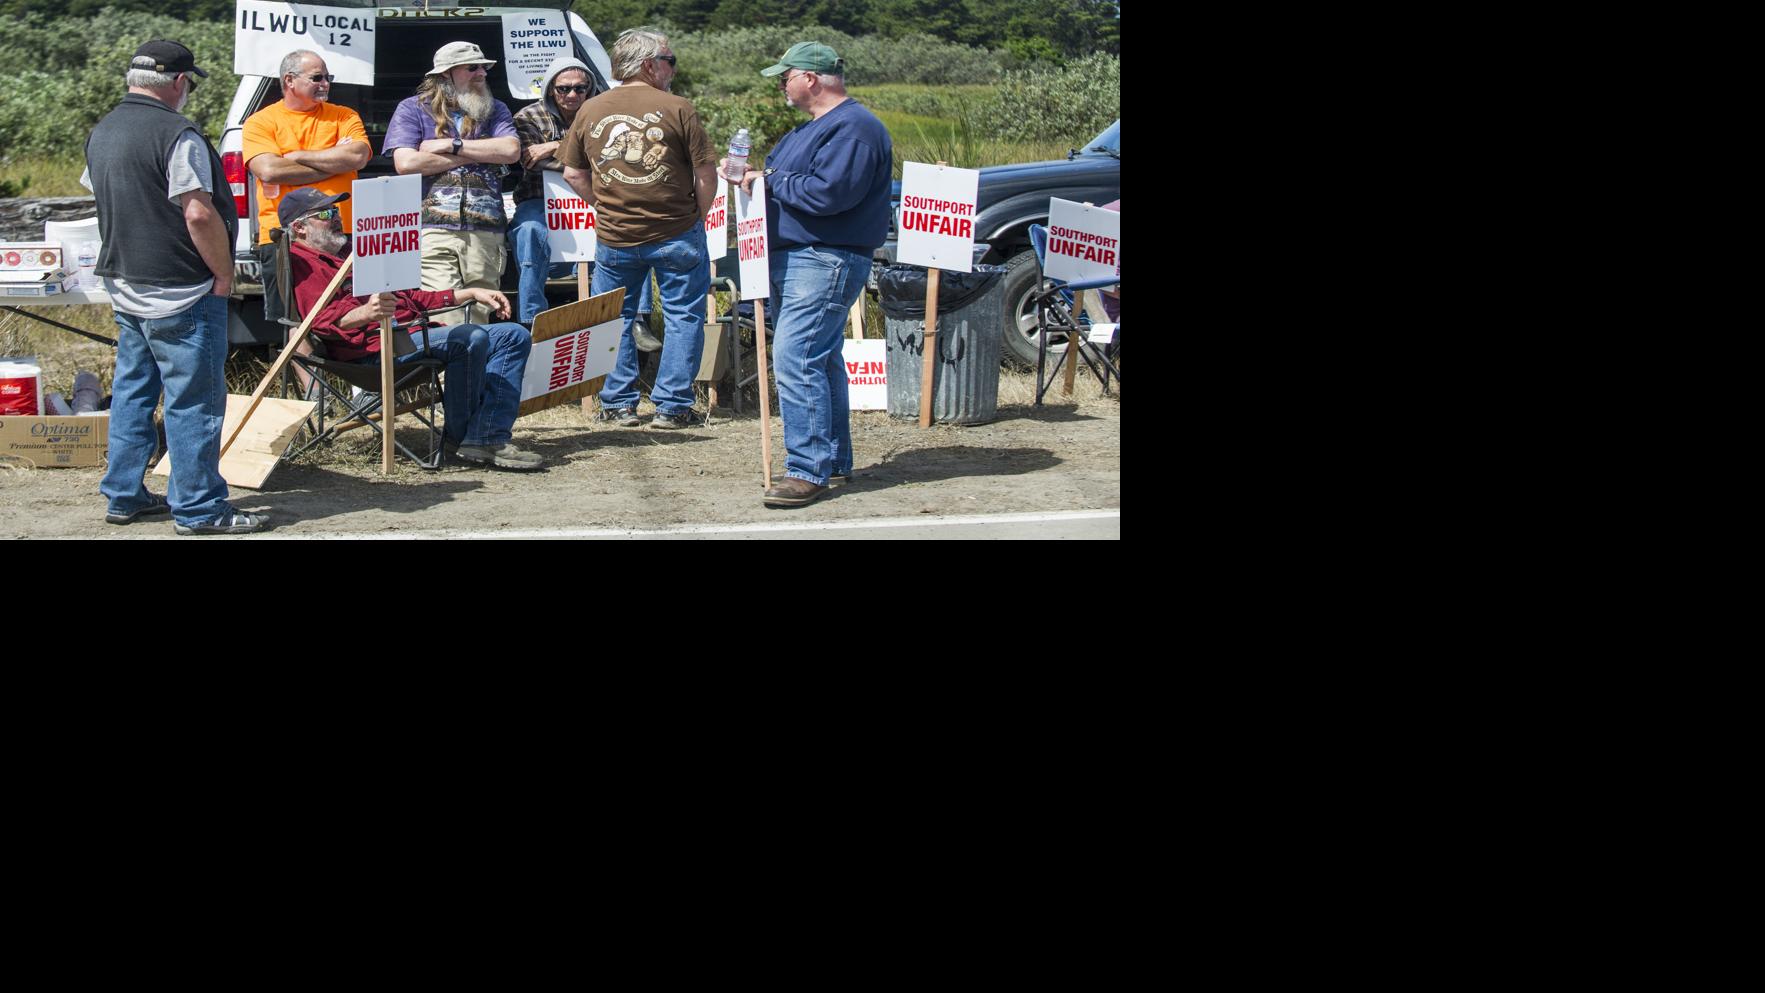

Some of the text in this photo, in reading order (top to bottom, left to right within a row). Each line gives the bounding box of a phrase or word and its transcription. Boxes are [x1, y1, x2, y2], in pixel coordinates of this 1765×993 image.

[241, 10, 373, 35] ILWU LOCAL
[528, 18, 546, 26] WE
[329, 32, 352, 47] 12
[510, 29, 565, 38] SUPPORT
[510, 40, 567, 49] THE ILWU
[904, 195, 974, 216] SOUTHPORT
[356, 212, 420, 232] SOUTHPORT
[737, 217, 764, 237] SOUTHPORT
[902, 210, 972, 239] UNFAIR
[356, 229, 420, 258] UNFAIR
[1050, 225, 1118, 249] SOUTHPORT
[739, 235, 766, 262] UNFAIR
[1049, 237, 1117, 266] UNFAIR
[548, 335, 576, 391] UNFAIR
[571, 330, 591, 383] SOUTHPORT
[31, 422, 91, 437] Optima
